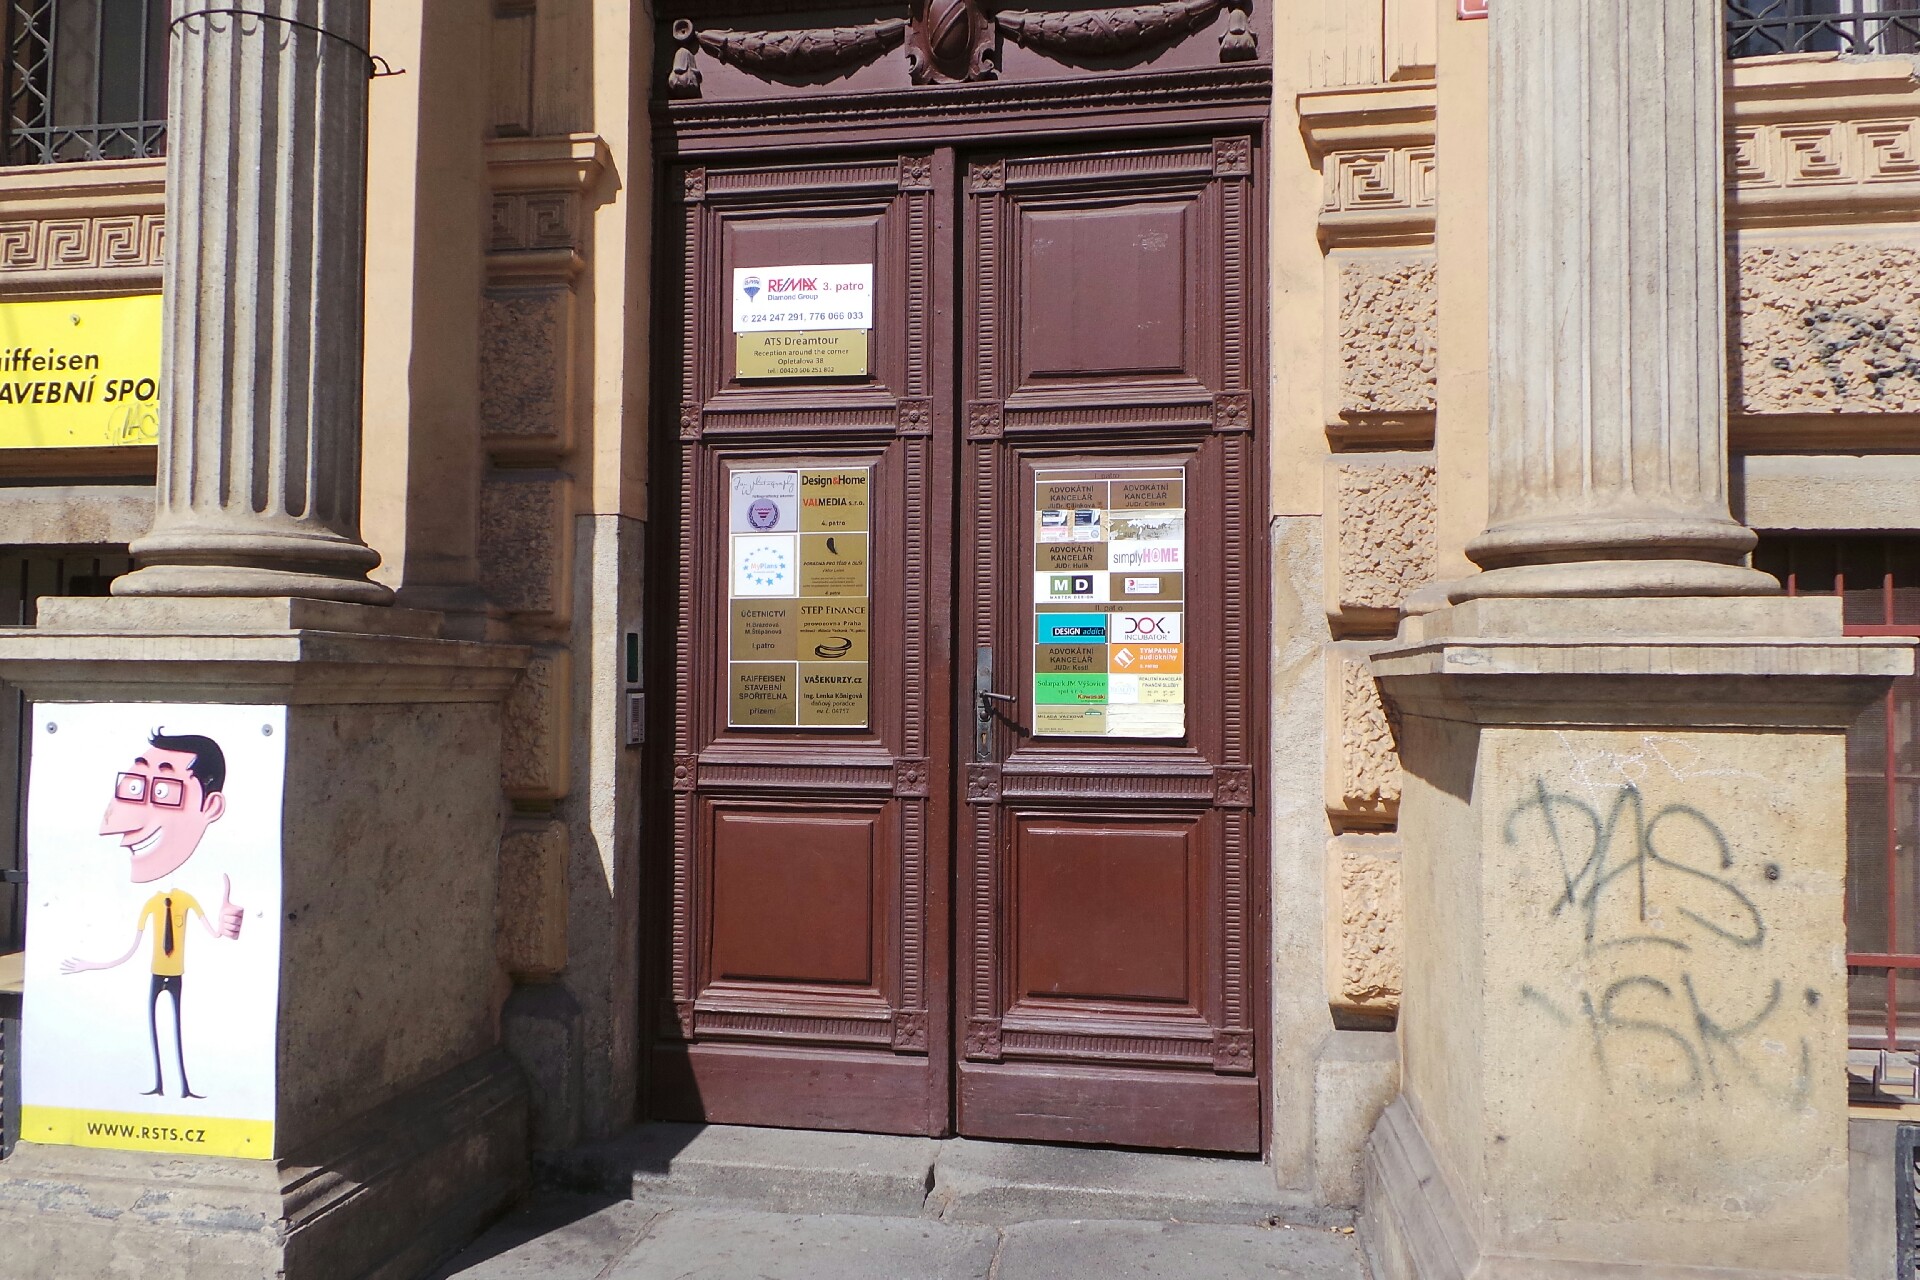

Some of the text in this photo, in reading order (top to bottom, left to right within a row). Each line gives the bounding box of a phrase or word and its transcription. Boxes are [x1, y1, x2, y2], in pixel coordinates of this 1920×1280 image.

[768, 278, 864, 292] RE/MAX 3. patro
[764, 336, 838, 346] ATS Dreamtour
[104, 378, 160, 402] SPO
[1049, 485, 1094, 493] ADVOKÁTNÍ
[1123, 483, 1168, 491] ADVOKÁTNÍ
[803, 498, 846, 507] VALMEDIA
[801, 606, 823, 615] STEP
[804, 675, 862, 684] VAŠEKURZY.cz
[88, 1122, 206, 1142] WWW.RSTS.CZ
